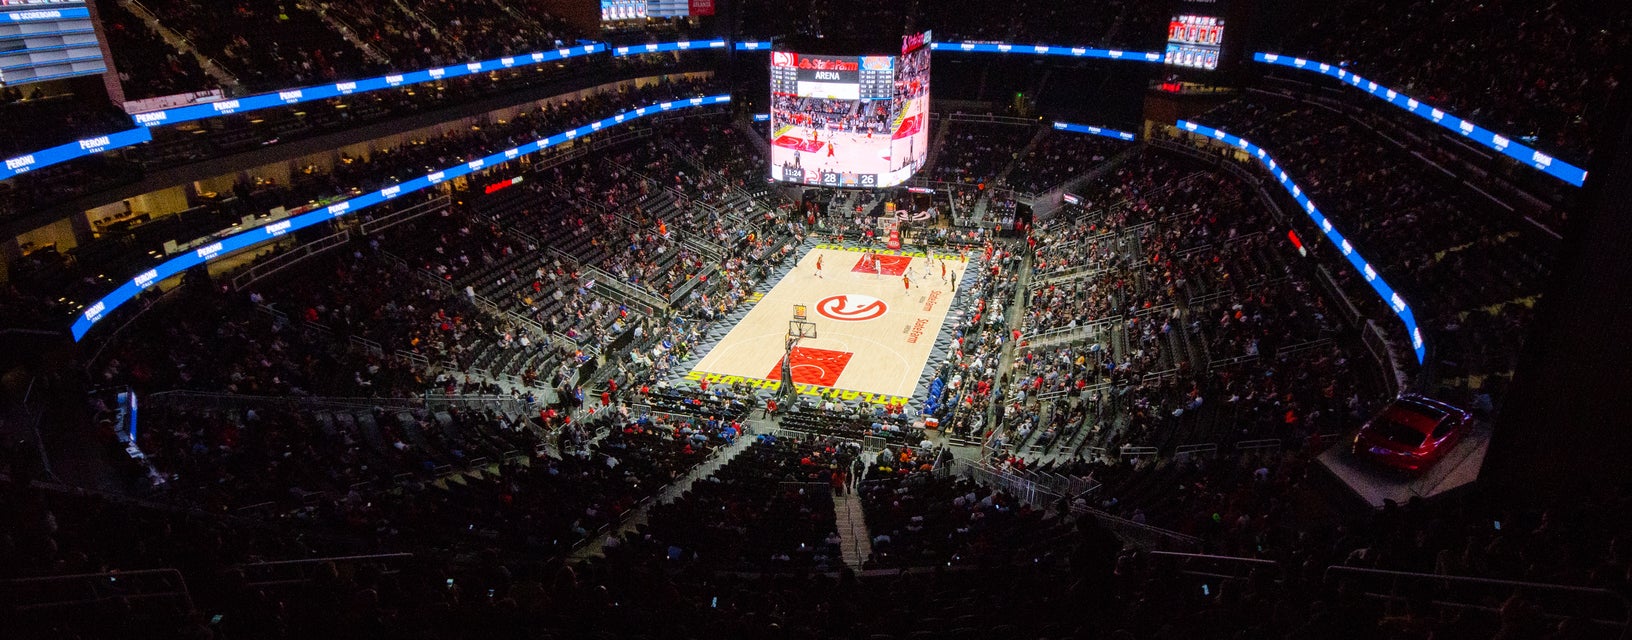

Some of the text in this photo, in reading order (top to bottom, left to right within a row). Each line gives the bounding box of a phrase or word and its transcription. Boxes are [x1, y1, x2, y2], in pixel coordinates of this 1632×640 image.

[20, 11, 61, 19] SCOREBOARD
[835, 60, 859, 71] Farm
[815, 71, 840, 80] ARENA
[279, 90, 303, 100] PERONI
[213, 99, 241, 111] PERONI
[135, 111, 168, 123] PERONI
[79, 135, 111, 149] PERONI
[5, 154, 36, 170] PERONI
[785, 168, 801, 177] 11:24
[824, 173, 836, 183] 28
[861, 174, 874, 184] 26
[265, 219, 292, 234] PERONI
[197, 242, 224, 258] PERONI
[134, 269, 159, 287] PERONI
[85, 301, 106, 321] PERONI
